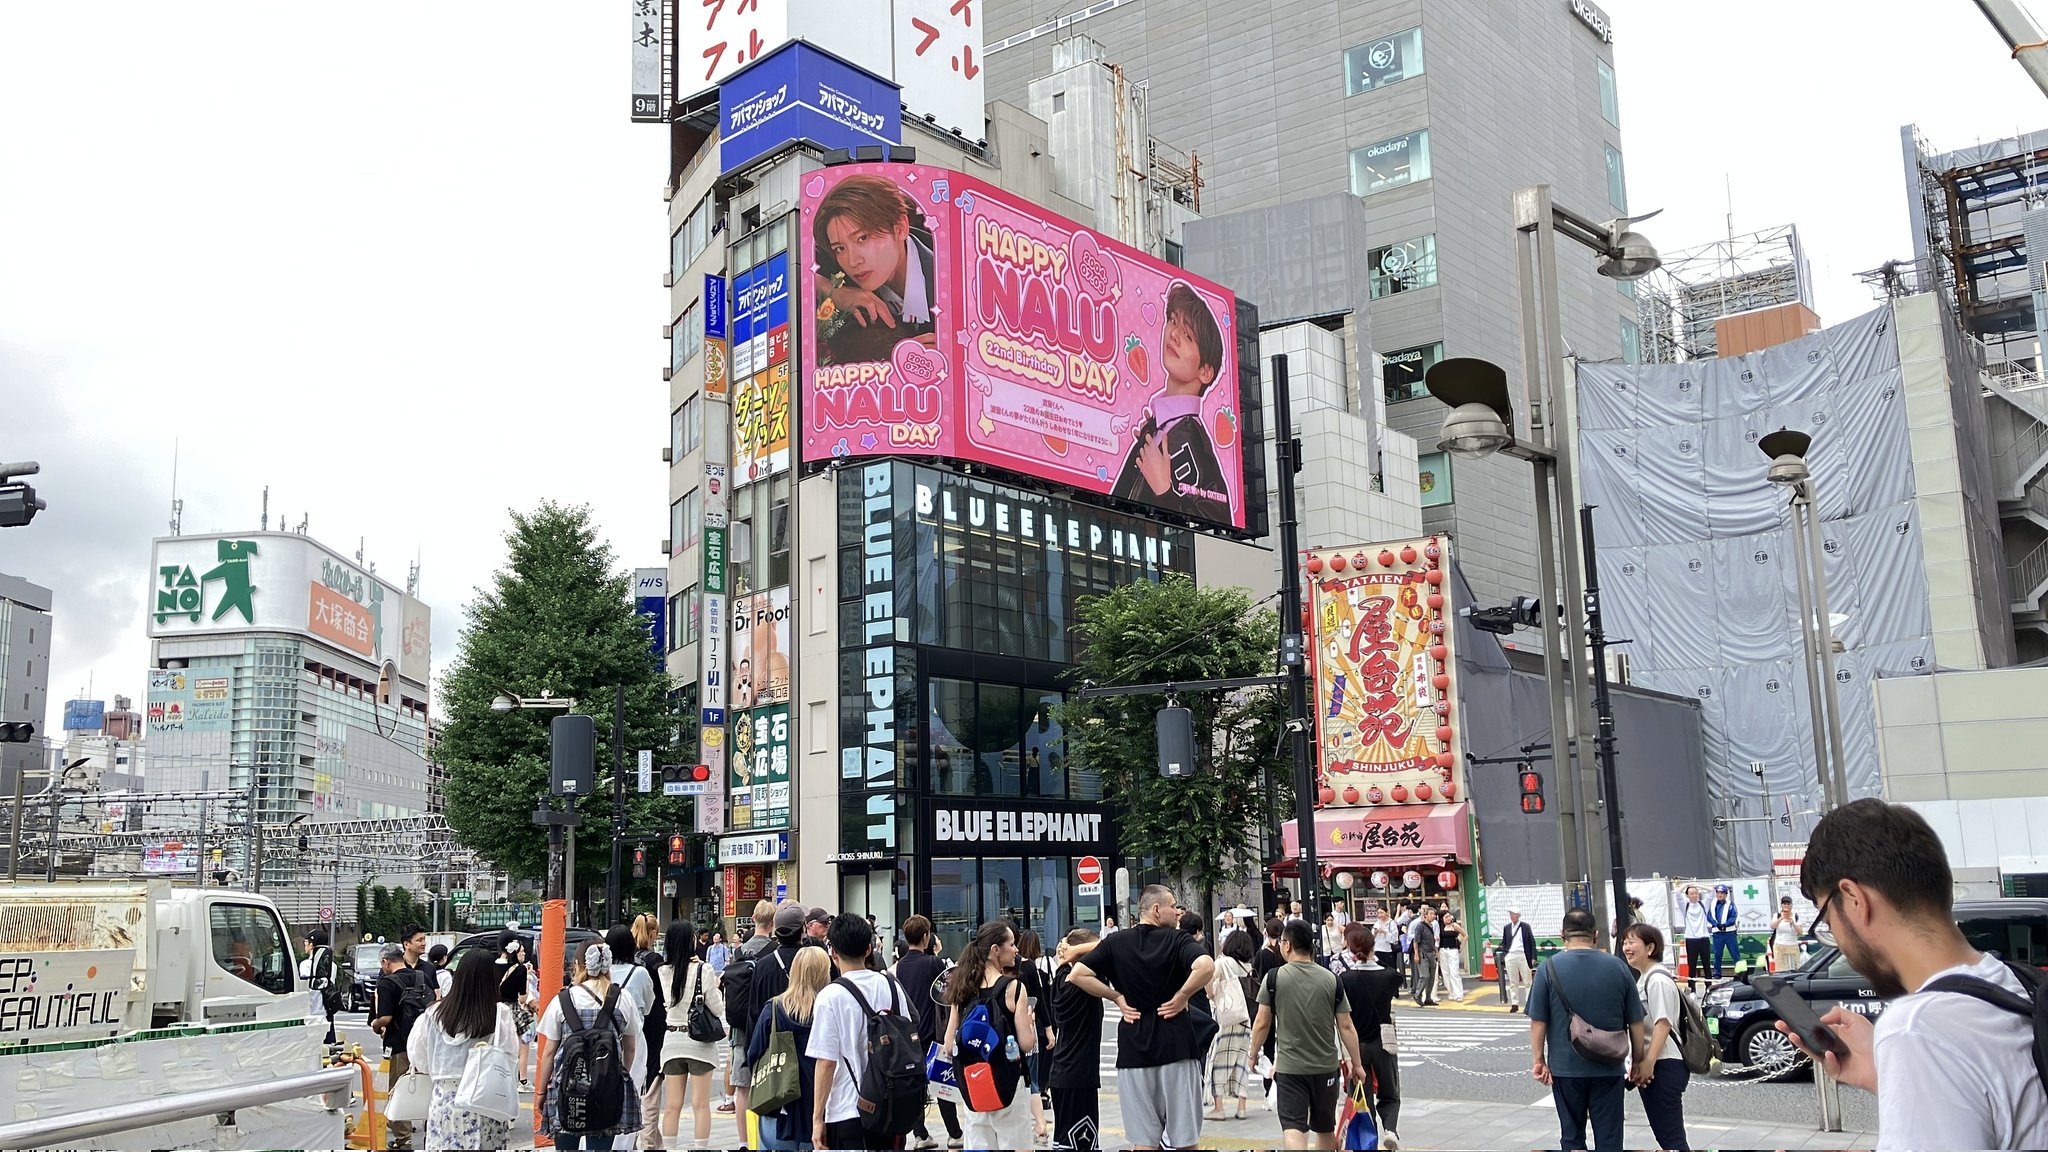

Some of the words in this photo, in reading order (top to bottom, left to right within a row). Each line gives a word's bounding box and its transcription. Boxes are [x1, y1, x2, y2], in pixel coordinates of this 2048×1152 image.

[635, 98, 657, 113] 9階
[730, 84, 787, 130] アパマンショップ
[818, 89, 885, 131] アパマンショップ
[1367, 138, 1408, 158] okadaya
[978, 218, 1067, 283] HAPPY
[738, 273, 784, 312] アパマンショップ
[978, 258, 1117, 361] NALU
[769, 346, 775, 358] 6
[782, 340, 788, 353] F
[985, 341, 1014, 363] 22nd
[1016, 349, 1060, 379] Birthday
[777, 364, 788, 378] 5F
[814, 363, 892, 392] HAPPY
[903, 360, 932, 379] 07.03
[1070, 355, 1117, 398] DAY
[737, 381, 780, 427] ダーツ
[813, 385, 941, 430] NALU
[743, 402, 788, 451] グッズ
[892, 424, 941, 447] DAY
[915, 483, 1172, 567] BLUEELEPHANT
[159, 564, 200, 588] TA
[708, 530, 721, 590] 宝石広場
[321, 557, 364, 603] たのめーる
[1342, 574, 1404, 590] YATAIEN
[157, 587, 201, 611] NO
[315, 596, 369, 645] 大塚商会
[710, 599, 719, 633] 高価買取
[735, 615, 751, 632] Dr
[756, 604, 790, 627] Foot
[863, 460, 896, 848] BLUEELEPHANT
[1345, 594, 1416, 751] 屋台苑
[187, 707, 229, 721] Kaleido
[708, 712, 720, 722] 1F
[754, 712, 788, 746] 宝石
[753, 745, 788, 779] 広場
[1352, 759, 1416, 773] SHINJUKU
[666, 784, 704, 793] 自転車専用
[936, 809, 993, 842] BLUE
[996, 811, 1102, 842] ELEPHANT
[1361, 821, 1425, 853] 屋台苑
[780, 840, 787, 853] 1F
[838, 852, 855, 861] CROSS
[856, 850, 884, 860] SHINJUKU
